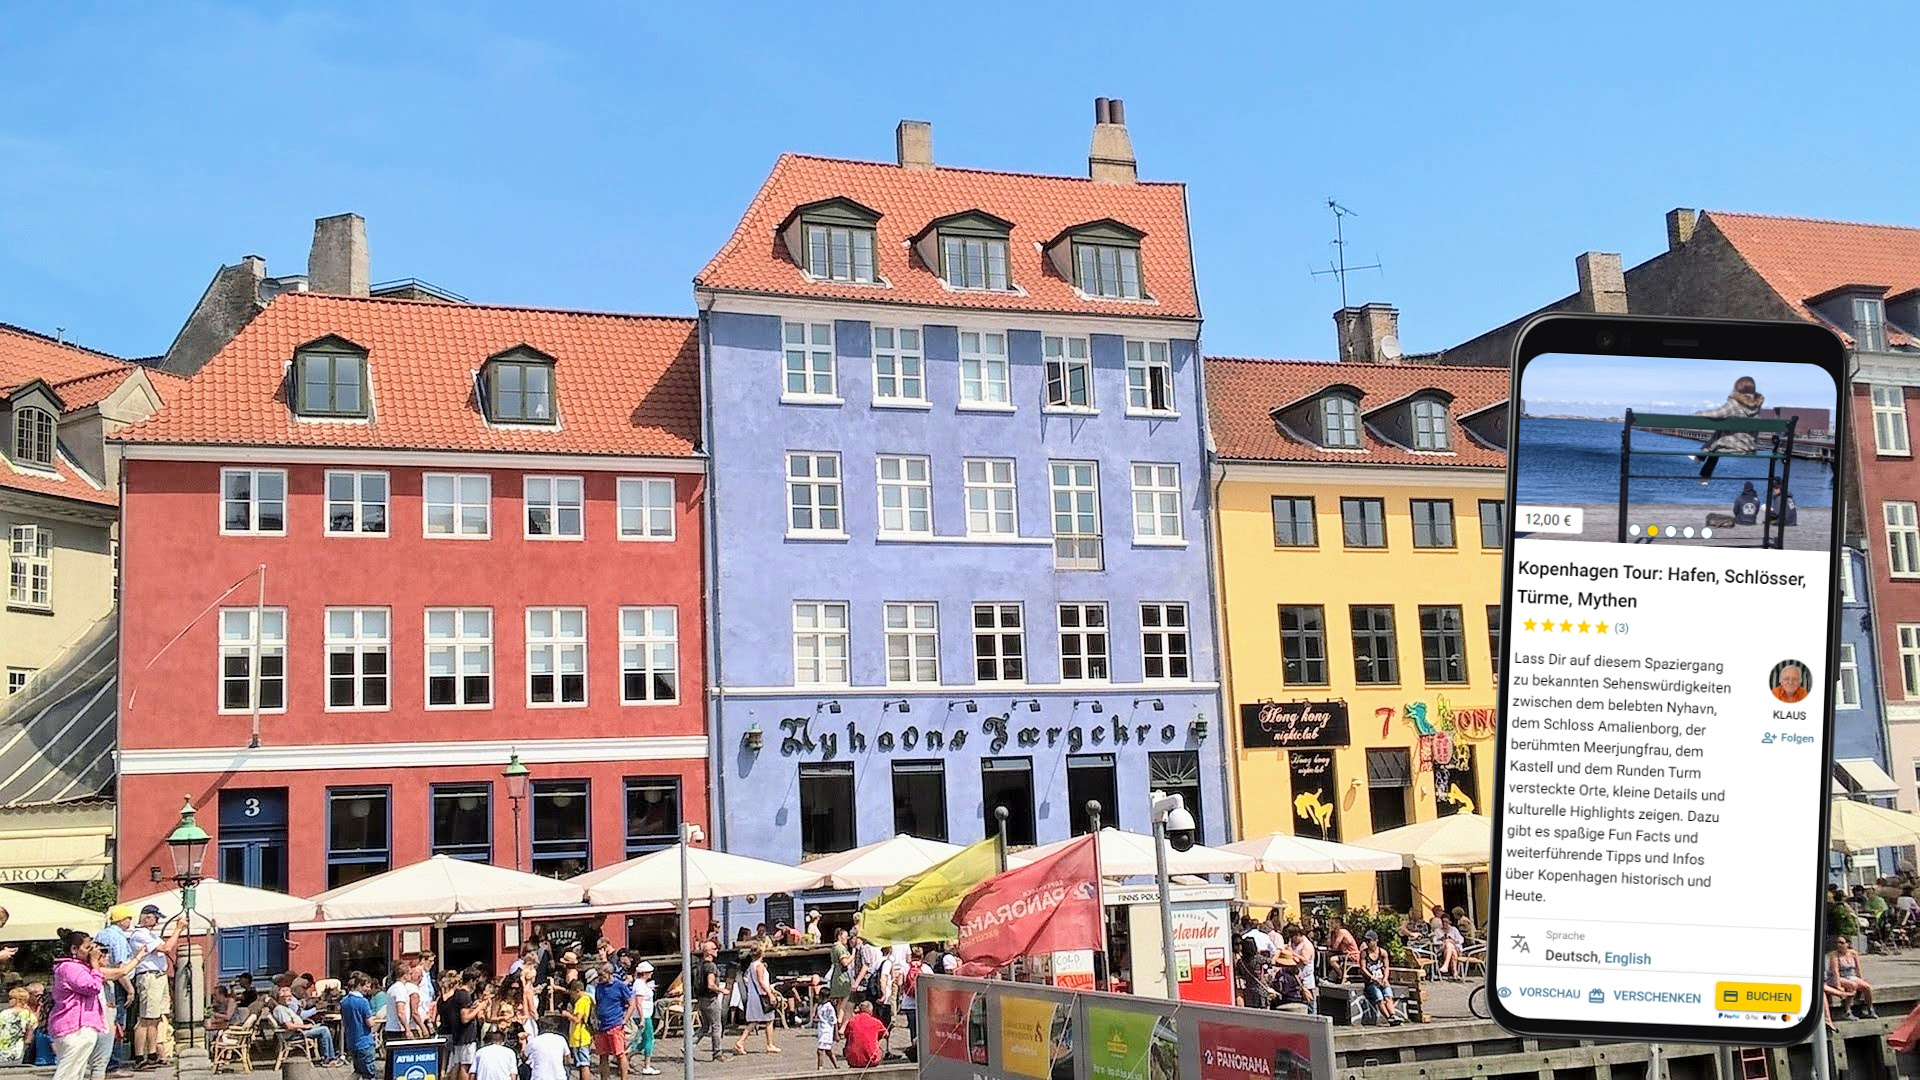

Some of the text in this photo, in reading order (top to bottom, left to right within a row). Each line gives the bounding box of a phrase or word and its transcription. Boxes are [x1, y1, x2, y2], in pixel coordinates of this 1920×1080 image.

[1525, 513, 1572, 527] 12,00 €
[1518, 560, 1807, 590] Kopenhagen Tour: Hafen, Schlösser,
[1516, 589, 1638, 611] Türme, Mythen
[1614, 622, 1629, 635] (3)
[1514, 651, 1724, 675] Lass Dir auf diesem Spaziergang
[1513, 673, 1732, 696] zu bekannten Sehenswürdigkeiten
[1512, 695, 1718, 717] zwischen dem belebten Nyhavn,
[1772, 710, 1807, 721] KLAUS
[1258, 705, 1299, 732] Hong
[1375, 706, 1396, 740] 7
[1511, 716, 1707, 738] dem Schloss Amalienborg, der
[779, 712, 1177, 760] Nyhavns Færgekro
[1274, 727, 1320, 745] nightclub
[1780, 732, 1815, 745] Folgen
[1510, 737, 1704, 758] berühmten Meerjungfrau, dem
[1510, 759, 1702, 779] Kastell und dem Runden Turm
[1508, 782, 1726, 802] versteckte Orte, kleine Details und
[244, 797, 261, 818] 3
[1508, 802, 1720, 824] kulturelle Highlights zeigen. Dazu
[1506, 824, 1699, 844] gibt es spaßige Fun Facts und
[1506, 846, 1705, 866] weiterführende Tipps und Infos
[1505, 867, 1712, 888] über Kopenhagen historisch und
[1141, 892, 1161, 901] PØLS
[1504, 889, 1546, 902] Heute.
[1171, 922, 1221, 941] elænder
[1546, 930, 1585, 941] Sprache
[1545, 949, 1652, 967] Deutsch, English
[1519, 986, 1581, 999] VORSCHAU
[1613, 989, 1702, 1004] VERSCHENKEN
[1746, 991, 1792, 1002] BUCHEN
[396, 1053, 436, 1064] ATM HERE
[1216, 1051, 1271, 1075] PANORAMA
